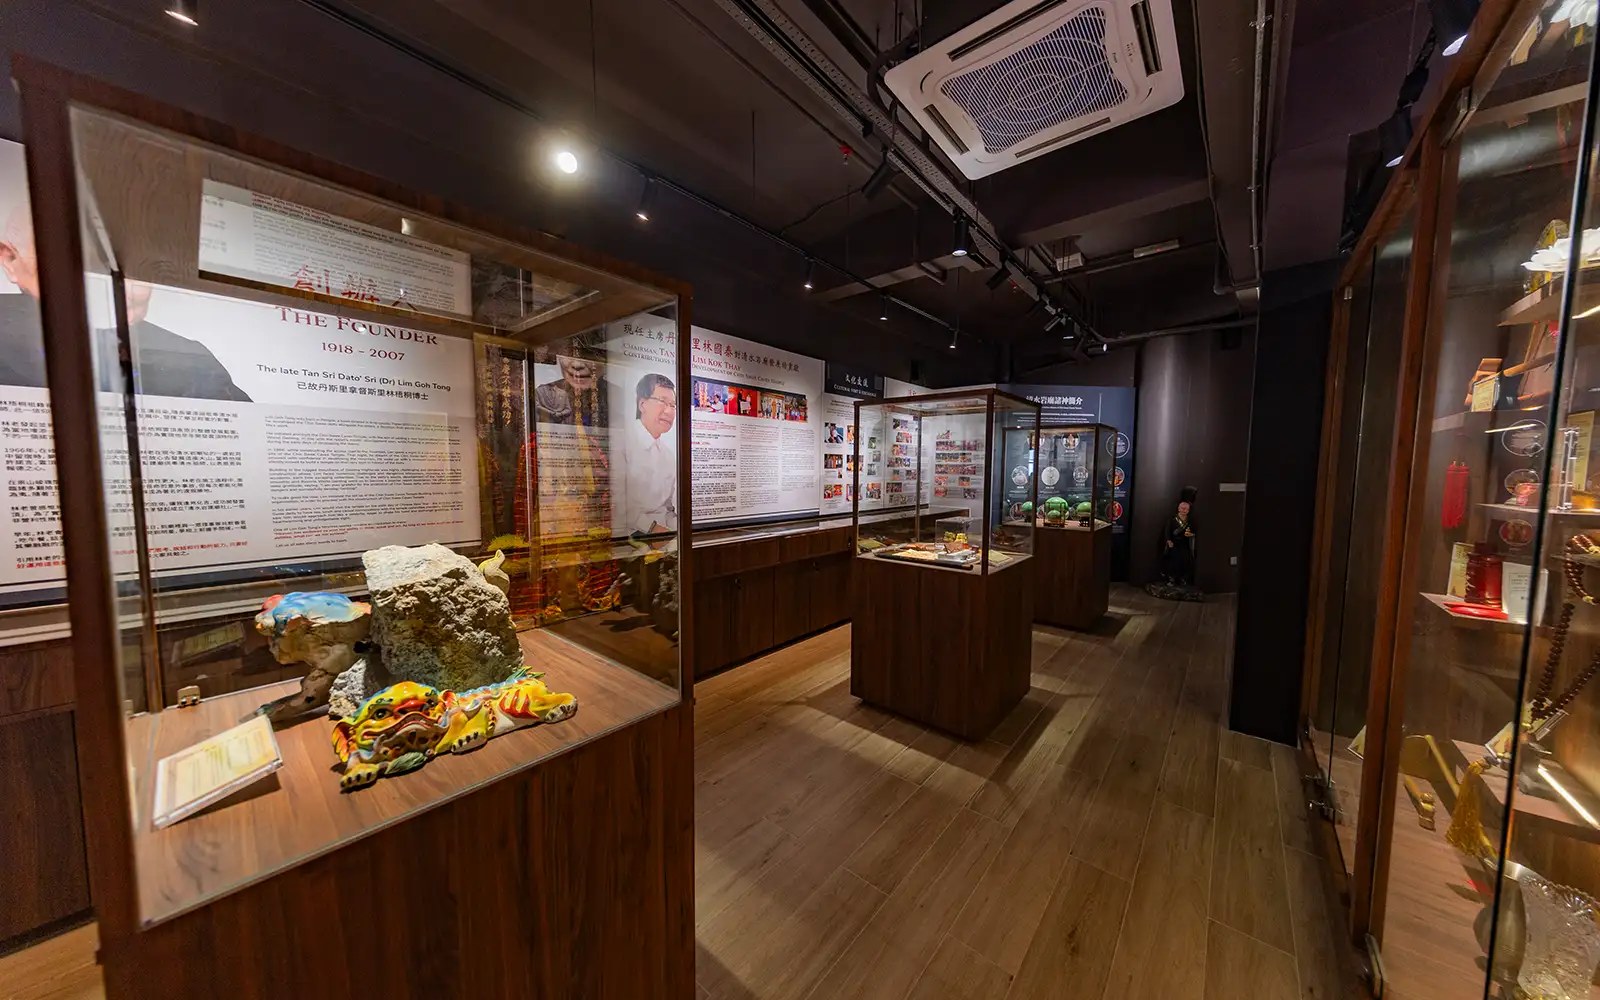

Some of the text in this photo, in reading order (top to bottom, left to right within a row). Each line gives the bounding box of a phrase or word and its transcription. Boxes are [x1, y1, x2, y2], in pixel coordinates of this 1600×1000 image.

[322, 342, 354, 355] 1918
[369, 348, 405, 362] 2007
[708, 358, 723, 368] KOK
[256, 364, 277, 374] The
[280, 366, 299, 376] late
[302, 368, 320, 378] Tan
[322, 370, 336, 379] Sri
[364, 375, 377, 384] Sri
[379, 376, 396, 387] (Dr)
[397, 378, 412, 387] Lim
[415, 381, 431, 390] Goh
[432, 382, 451, 393] Tong
[297, 381, 429, 401] 已故丹斯里拿督斯里林梧桐博士
